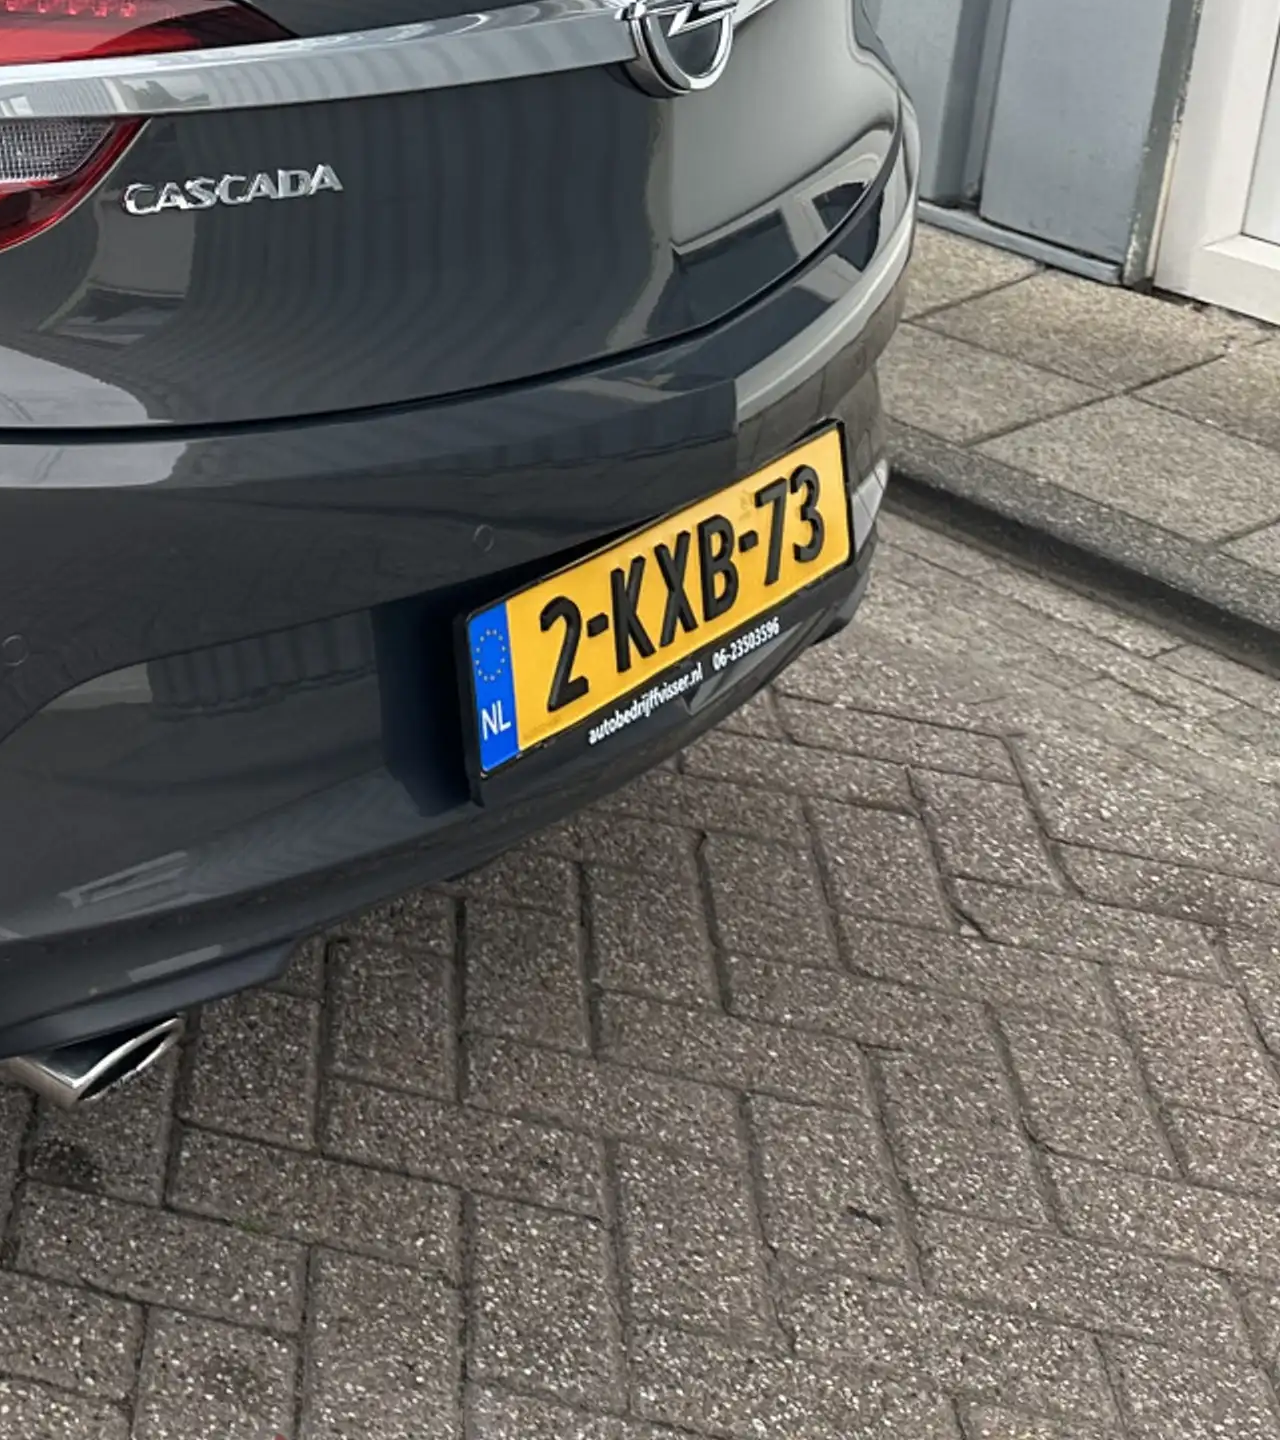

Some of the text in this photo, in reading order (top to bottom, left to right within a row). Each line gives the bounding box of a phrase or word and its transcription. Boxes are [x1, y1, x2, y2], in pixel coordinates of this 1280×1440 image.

[123, 164, 344, 216] CASCADA
[540, 464, 826, 712] 2-KXB-73
[480, 699, 511, 741] NL
[588, 616, 781, 744] autobedrijffvisser.nl 06-23503596
